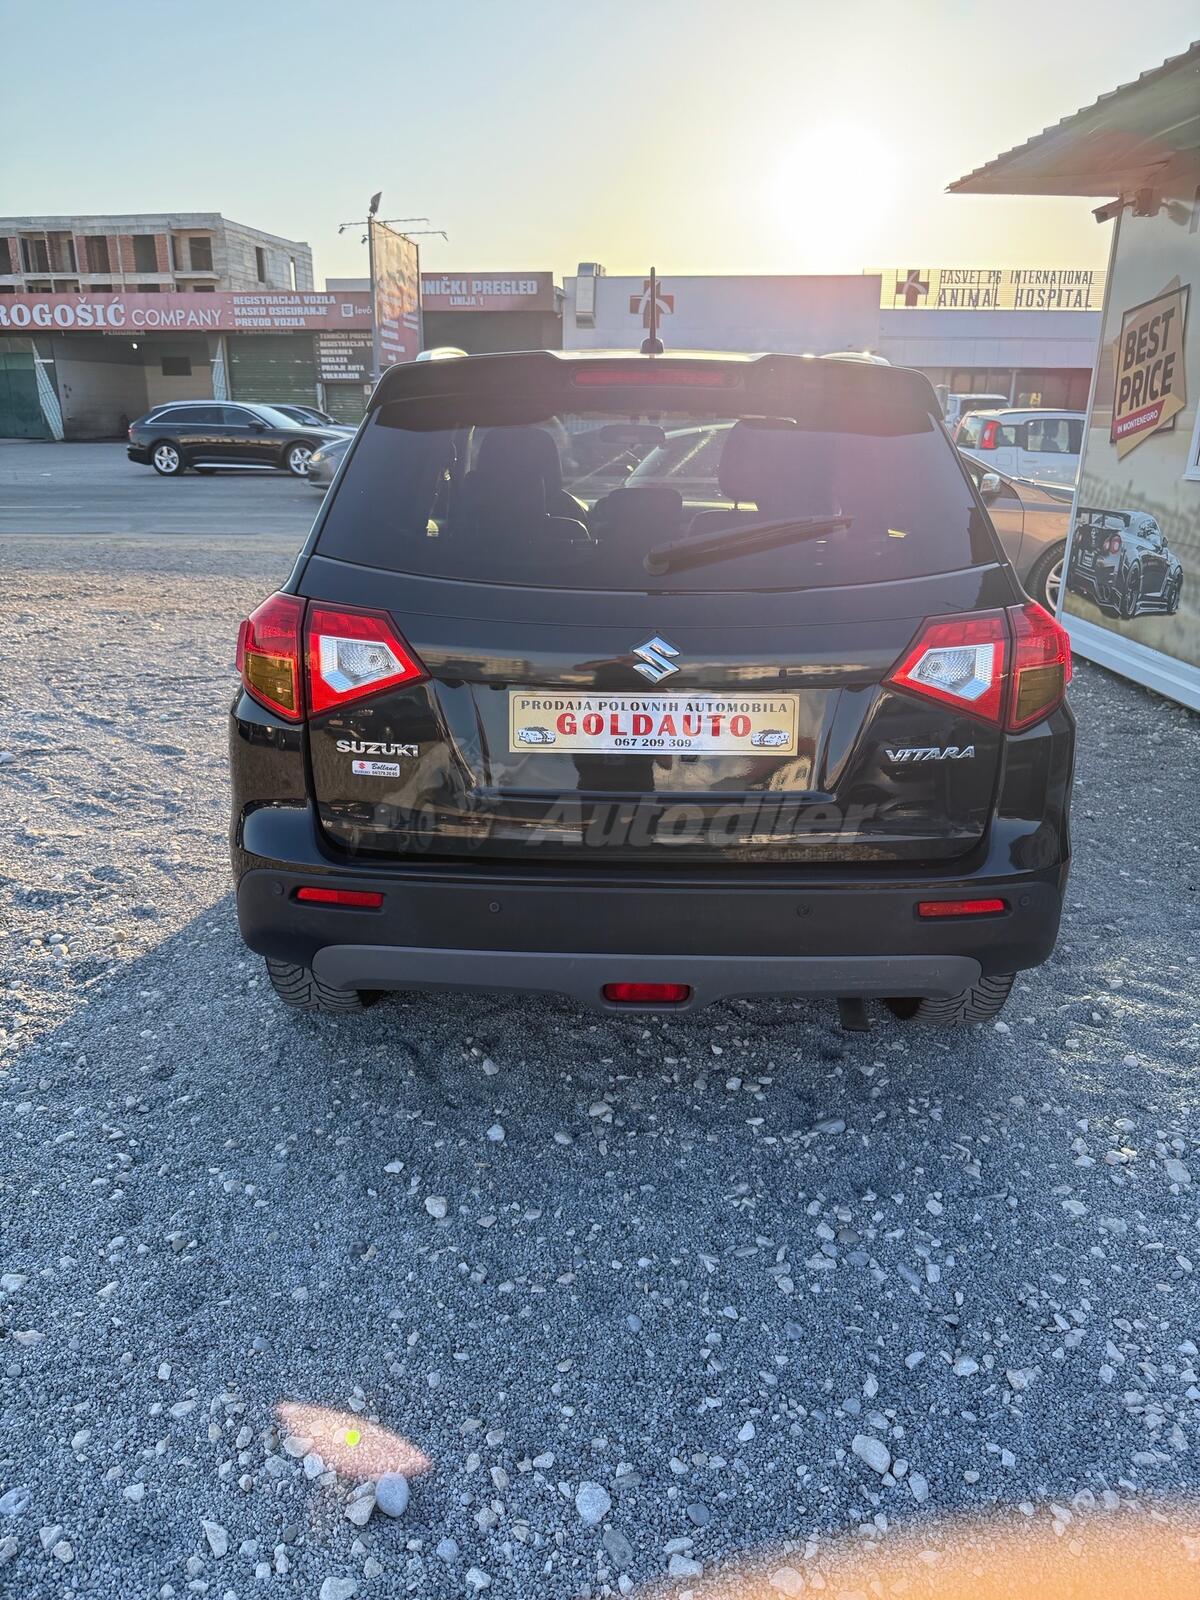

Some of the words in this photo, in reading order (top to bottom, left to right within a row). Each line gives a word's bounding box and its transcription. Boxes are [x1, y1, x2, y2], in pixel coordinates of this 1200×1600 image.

[1010, 269, 1095, 285] INTERNATIONAL
[472, 279, 538, 295] PREGLED
[233, 295, 301, 305] REGISTRACIJA
[303, 295, 337, 305] VOZILA
[938, 288, 1001, 307] ANIMAL
[1015, 288, 1092, 307] HOSPITAL
[131, 308, 222, 327] COMPANY
[234, 306, 266, 316] KASKO
[269, 306, 329, 316] OSIGURANJE
[274, 317, 306, 327] VOZILA
[1122, 306, 1176, 372] BEST
[1116, 352, 1176, 417] PRICE
[1123, 409, 1159, 433] MONTENEGRO
[521, 700, 593, 712] PRODAJA
[598, 701, 679, 713] POLOVNIH
[685, 702, 788, 713] AUTOMOBILA
[556, 712, 752, 738] GOLDAUTO
[336, 739, 419, 757] SUZUKI
[614, 738, 638, 747] 067
[641, 738, 665, 747] 209
[668, 739, 692, 748] 309
[885, 745, 976, 762] VITARA
